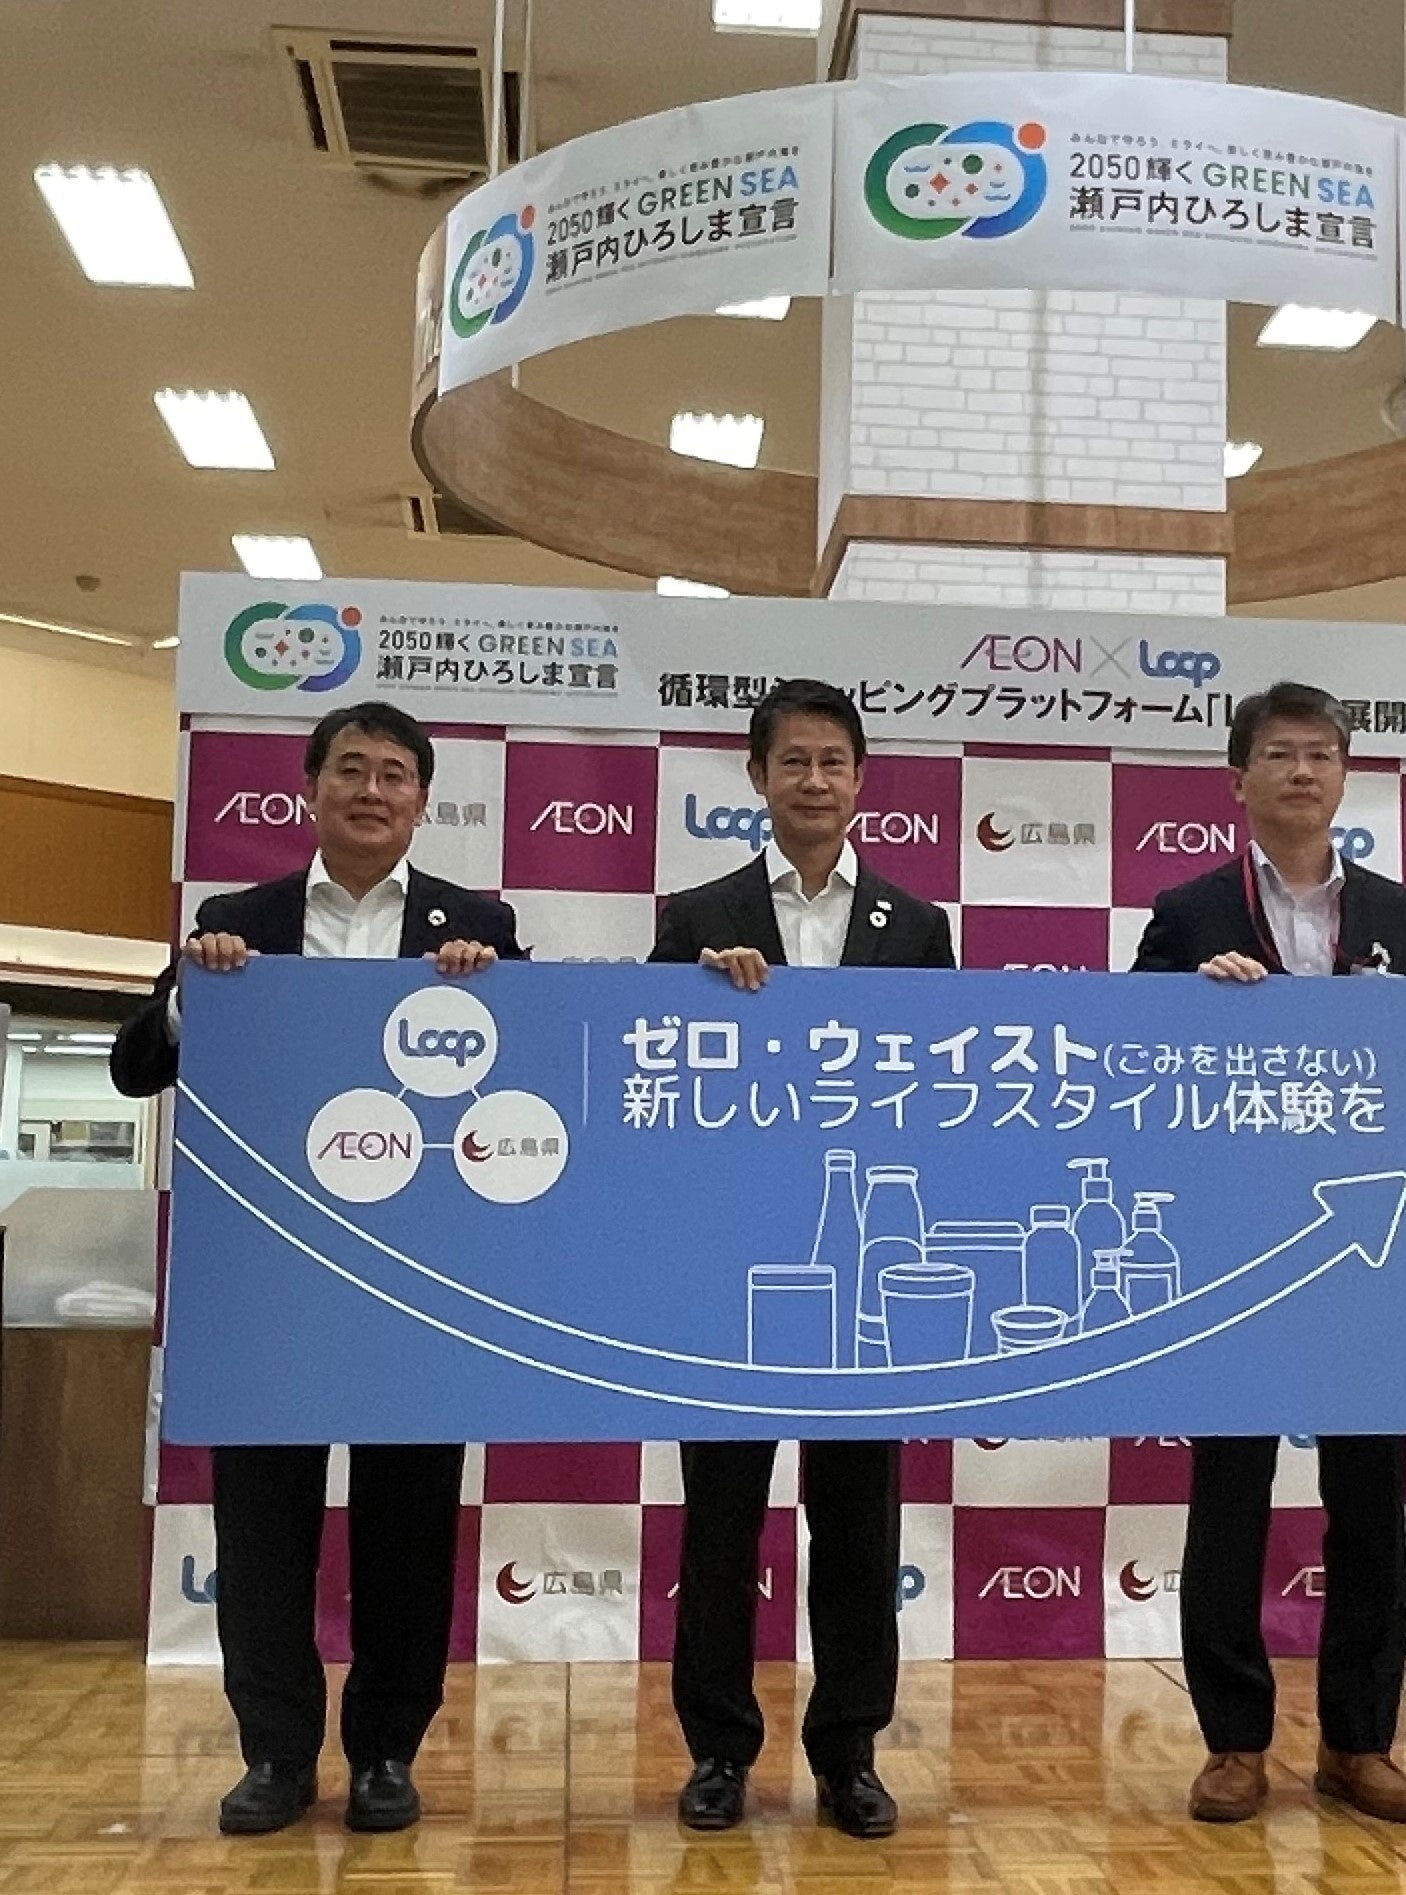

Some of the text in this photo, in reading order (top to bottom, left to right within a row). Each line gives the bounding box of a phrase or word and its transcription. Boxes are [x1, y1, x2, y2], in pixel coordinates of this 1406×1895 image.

[637, 175, 733, 217] GREEN
[740, 165, 800, 197] SEA
[1203, 162, 1311, 199] GREEN
[1317, 177, 1375, 210] SEA
[546, 198, 800, 285] 瀬戸内ひろしま宣言
[1069, 186, 1377, 249] 瀬戸内ひろしま宣言
[478, 634, 565, 655] GREEN
[570, 637, 618, 658] SEA
[376, 656, 619, 689] 瀬戸内ひろしま宣言
[623, 1073, 1385, 1135] 新しいライフスタイル体験を
